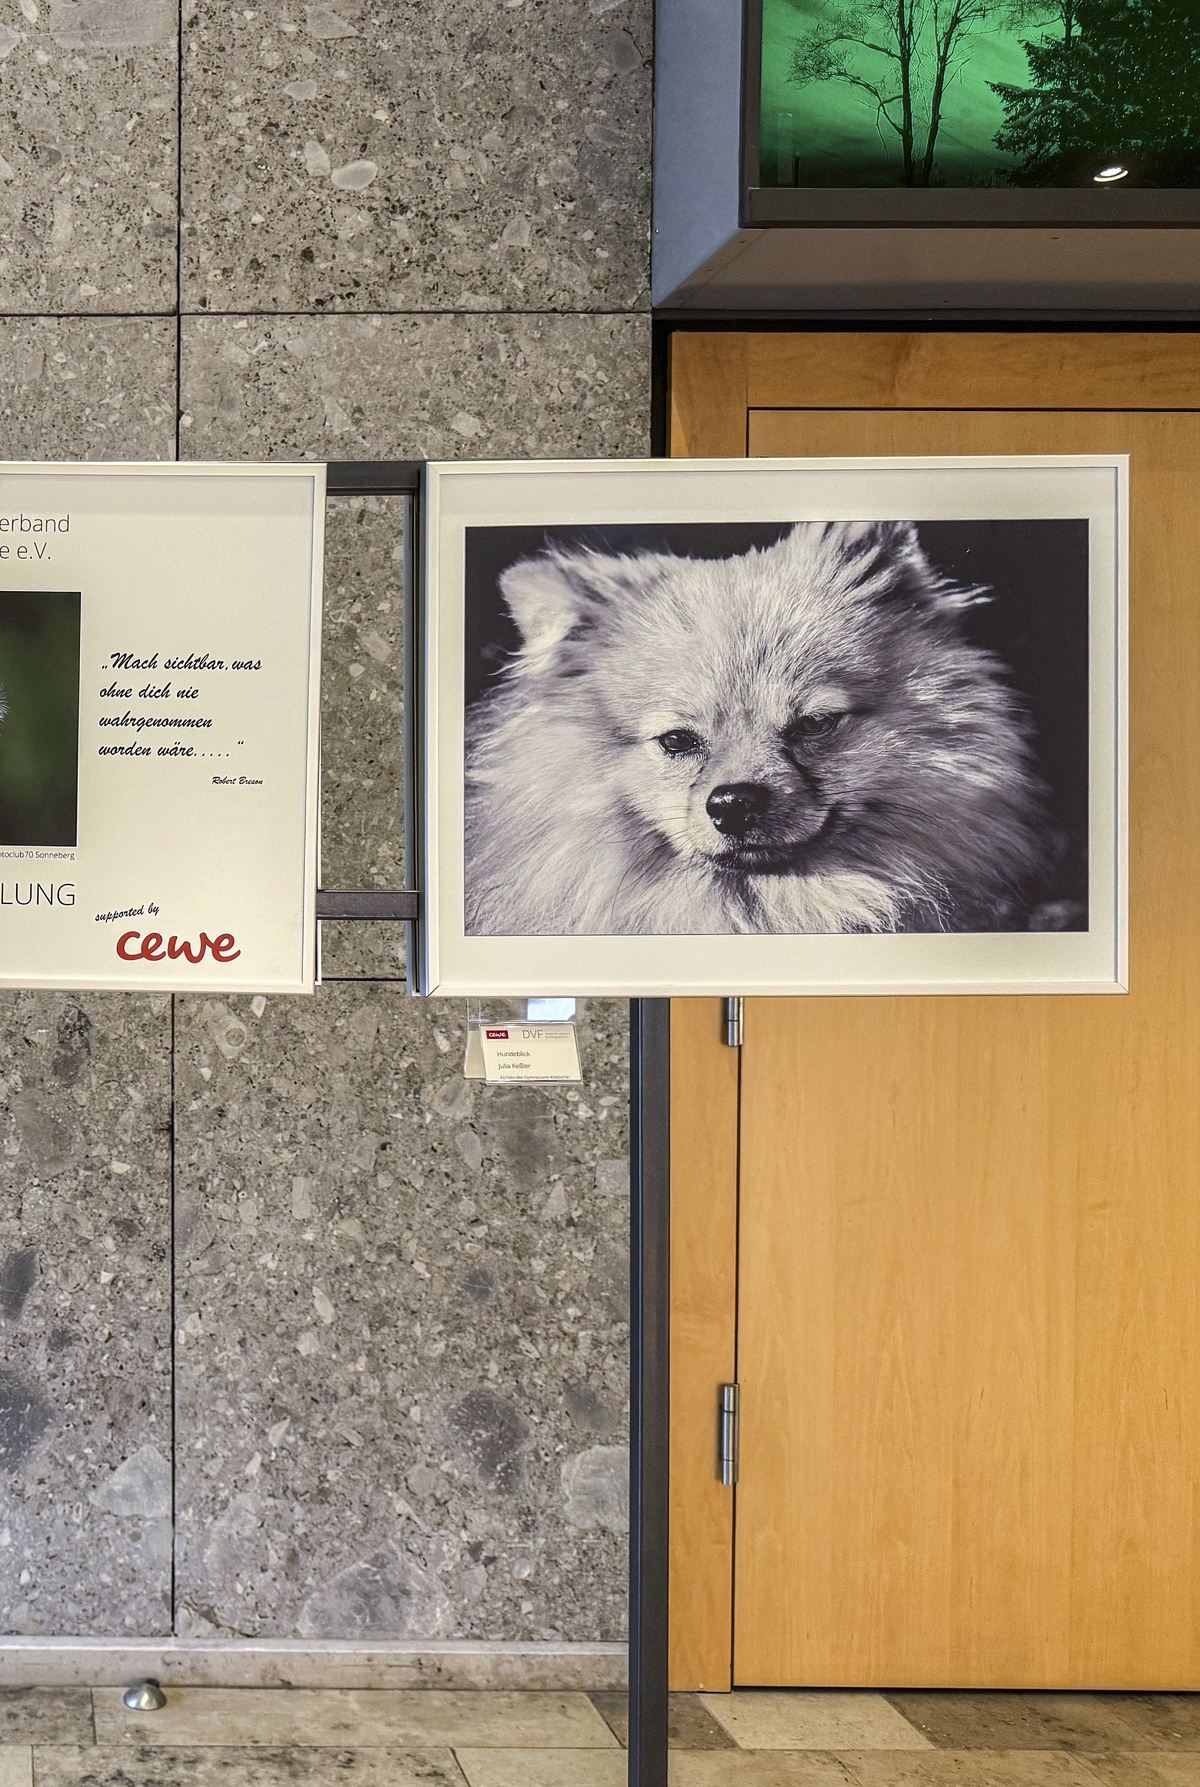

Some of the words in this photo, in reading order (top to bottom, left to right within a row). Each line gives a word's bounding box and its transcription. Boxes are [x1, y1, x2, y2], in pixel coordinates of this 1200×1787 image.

[16, 542, 52, 560] e.V.
[101, 652, 159, 670] „Mach
[99, 681, 133, 698] ohne
[138, 682, 171, 698] dich
[176, 686, 200, 699] nie
[98, 710, 213, 732] wahrgenommen
[98, 741, 151, 756] worden
[211, 776, 237, 785] Robert
[35, 851, 75, 860] Sonneberg
[95, 904, 144, 923] supported
[148, 902, 160, 916] by
[116, 930, 241, 964] cewe
[522, 1029, 543, 1039] DVF
